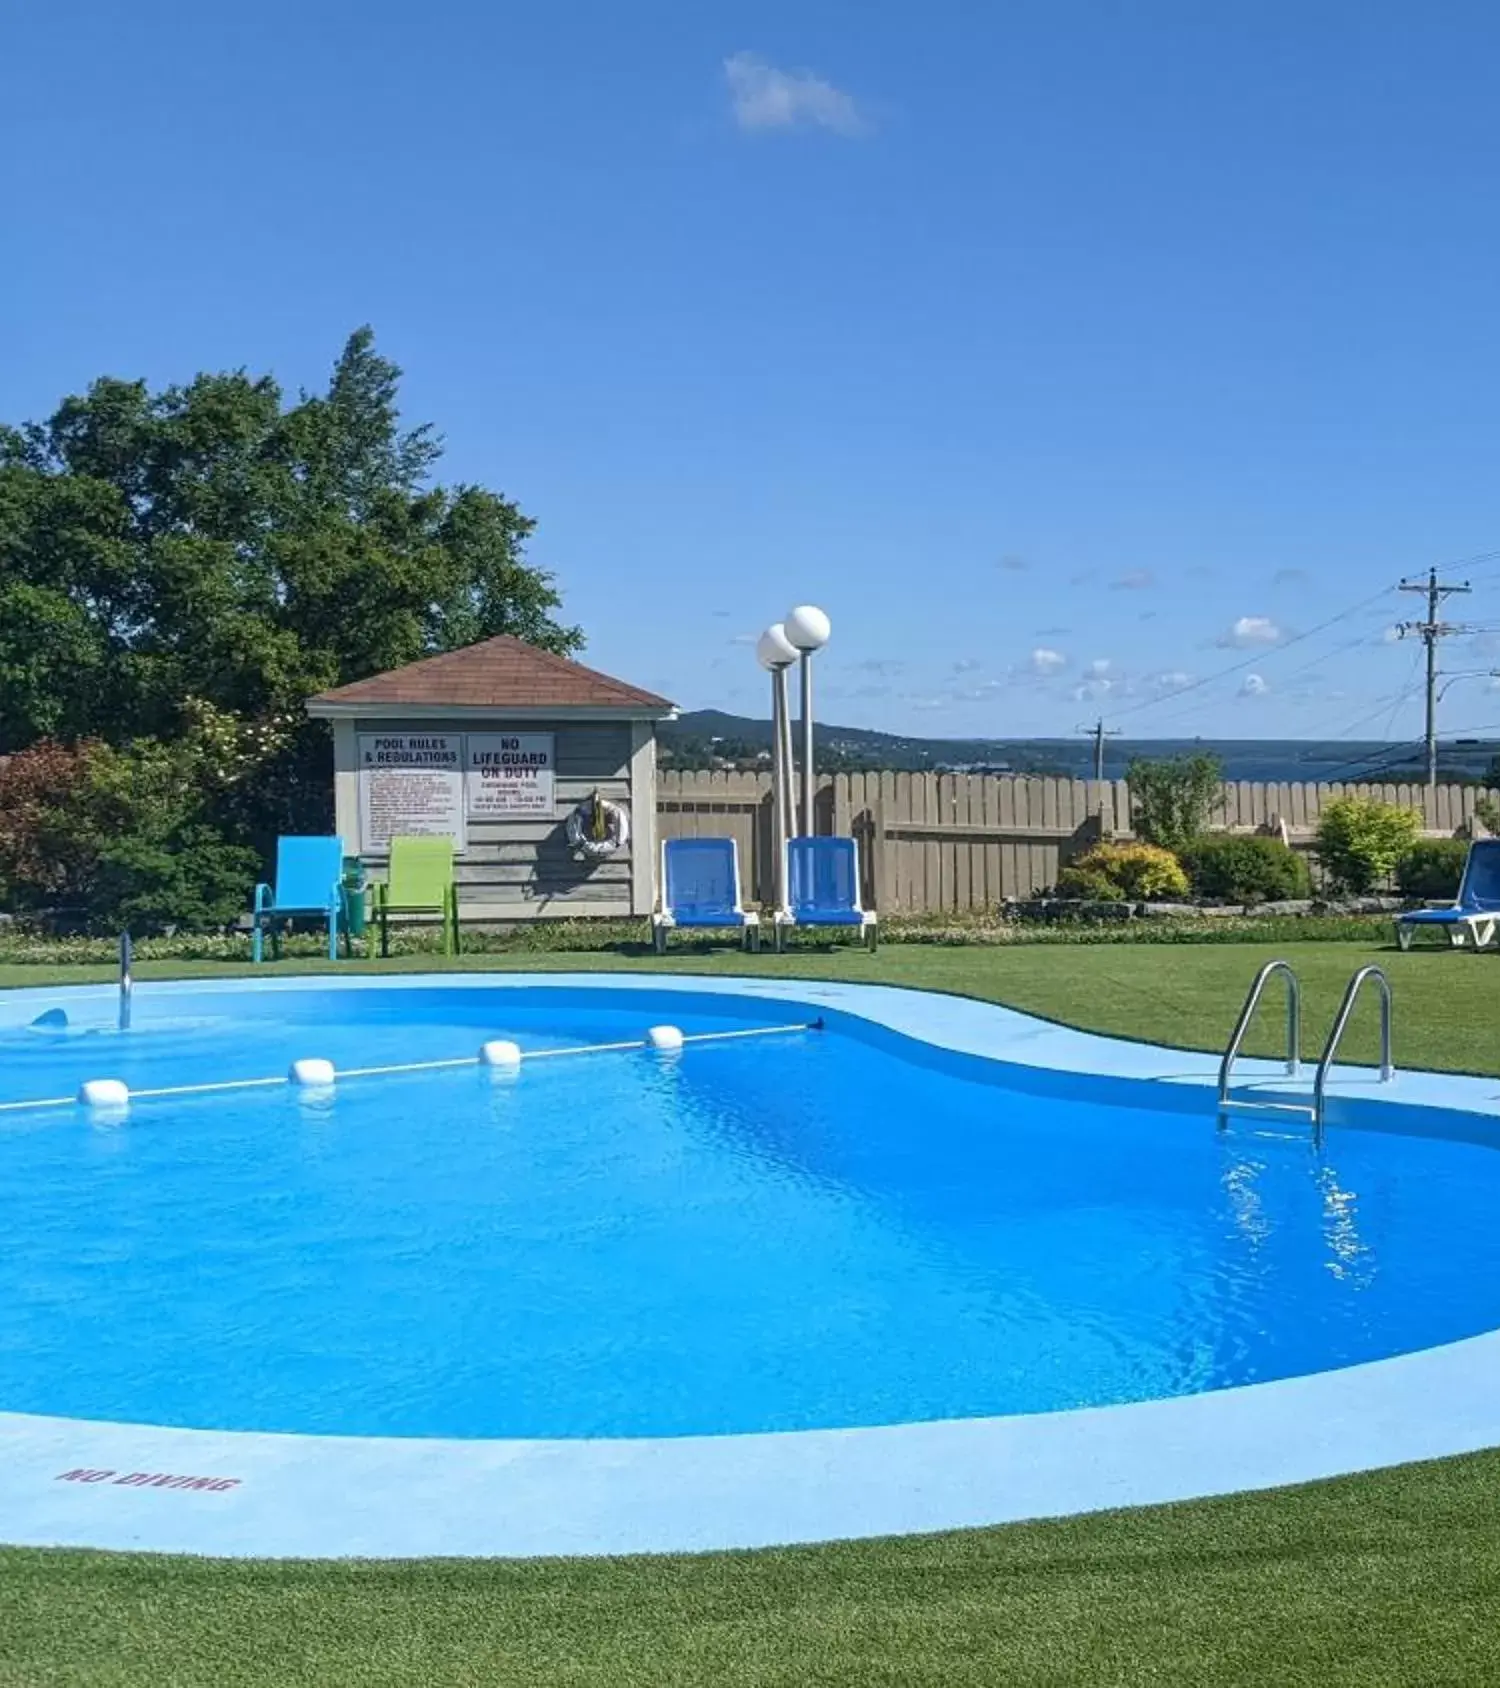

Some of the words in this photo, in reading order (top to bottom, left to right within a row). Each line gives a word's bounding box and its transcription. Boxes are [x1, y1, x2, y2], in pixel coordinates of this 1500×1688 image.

[375, 739, 403, 749] POOL
[410, 739, 447, 749] RULES
[501, 738, 520, 750] NO
[366, 752, 373, 762] &
[377, 751, 458, 763] REGULATIONS
[472, 752, 547, 765] LIFEGUARD
[482, 767, 500, 778] ON
[506, 767, 539, 778] DUTY
[54, 1468, 116, 1483] NO
[112, 1471, 244, 1491] DIVING
